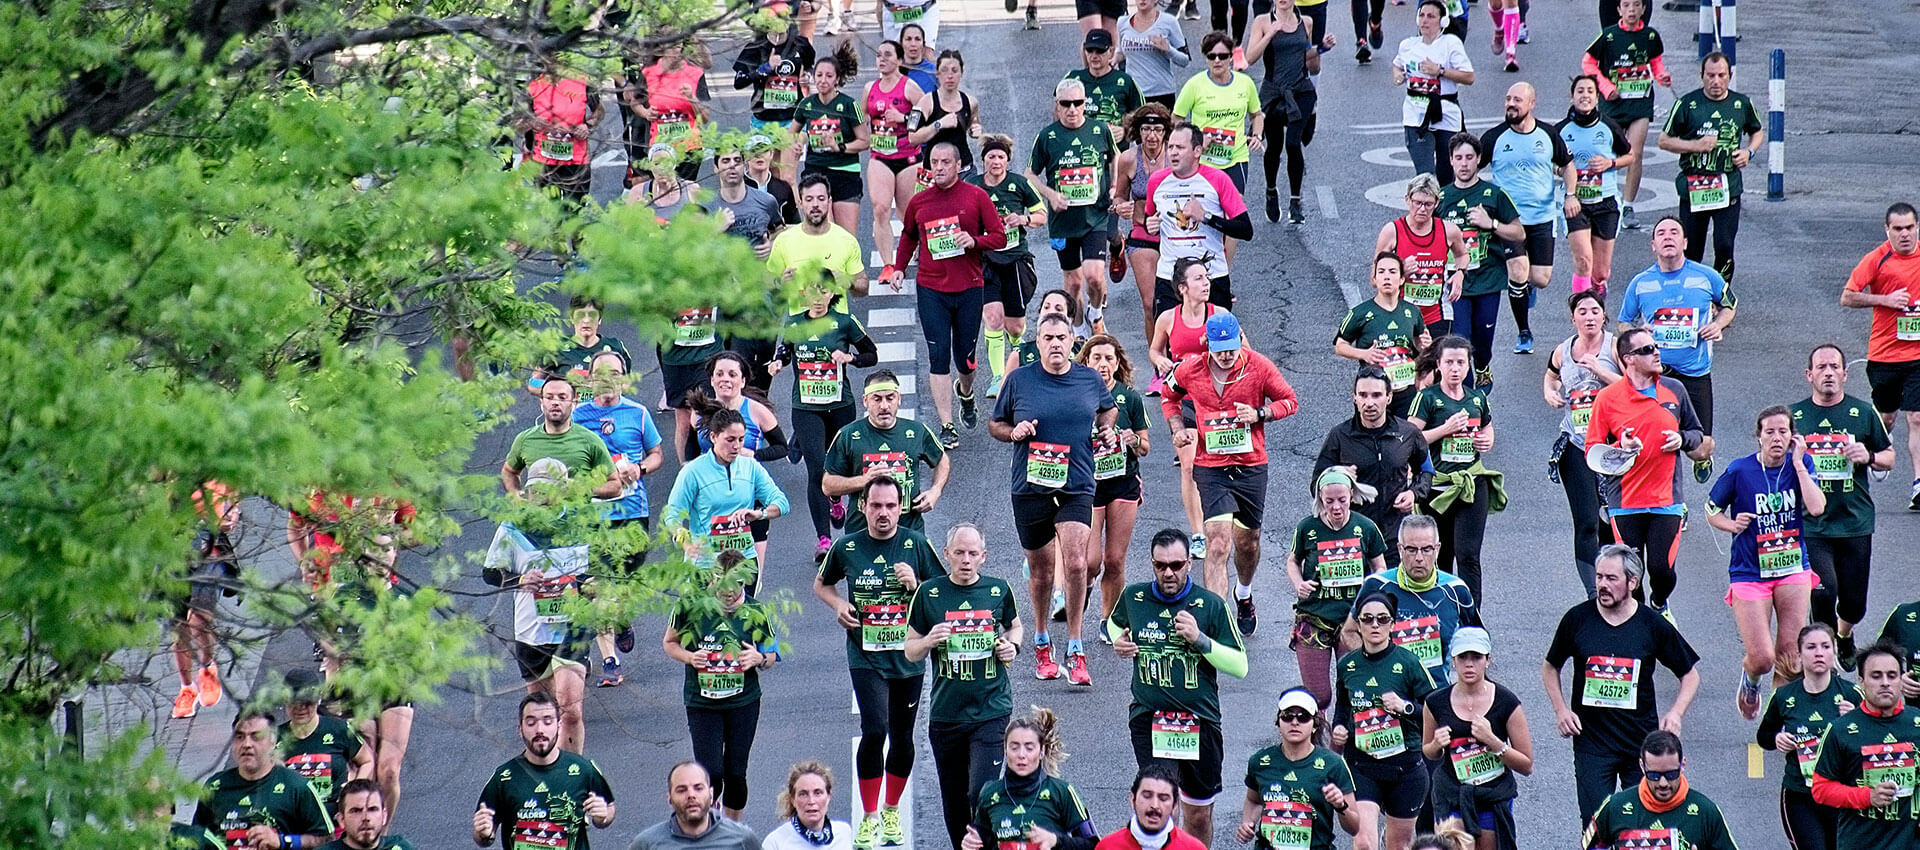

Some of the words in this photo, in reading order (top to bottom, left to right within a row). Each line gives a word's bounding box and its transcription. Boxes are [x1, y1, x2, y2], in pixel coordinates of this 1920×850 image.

[1206, 111, 1239, 120] RUNNING
[1059, 157, 1080, 165] MADRID
[1666, 331, 1684, 340] 26301
[1219, 433, 1239, 445] 43163
[1820, 460, 1842, 470] 42954
[1757, 514, 1777, 527] FOR
[1781, 511, 1795, 524] THE
[877, 632, 900, 641] 42804
[962, 639, 985, 650] 41756
[1599, 685, 1622, 697] 42572
[1168, 737, 1189, 748] 41644
[518, 810, 546, 819] MADRID
